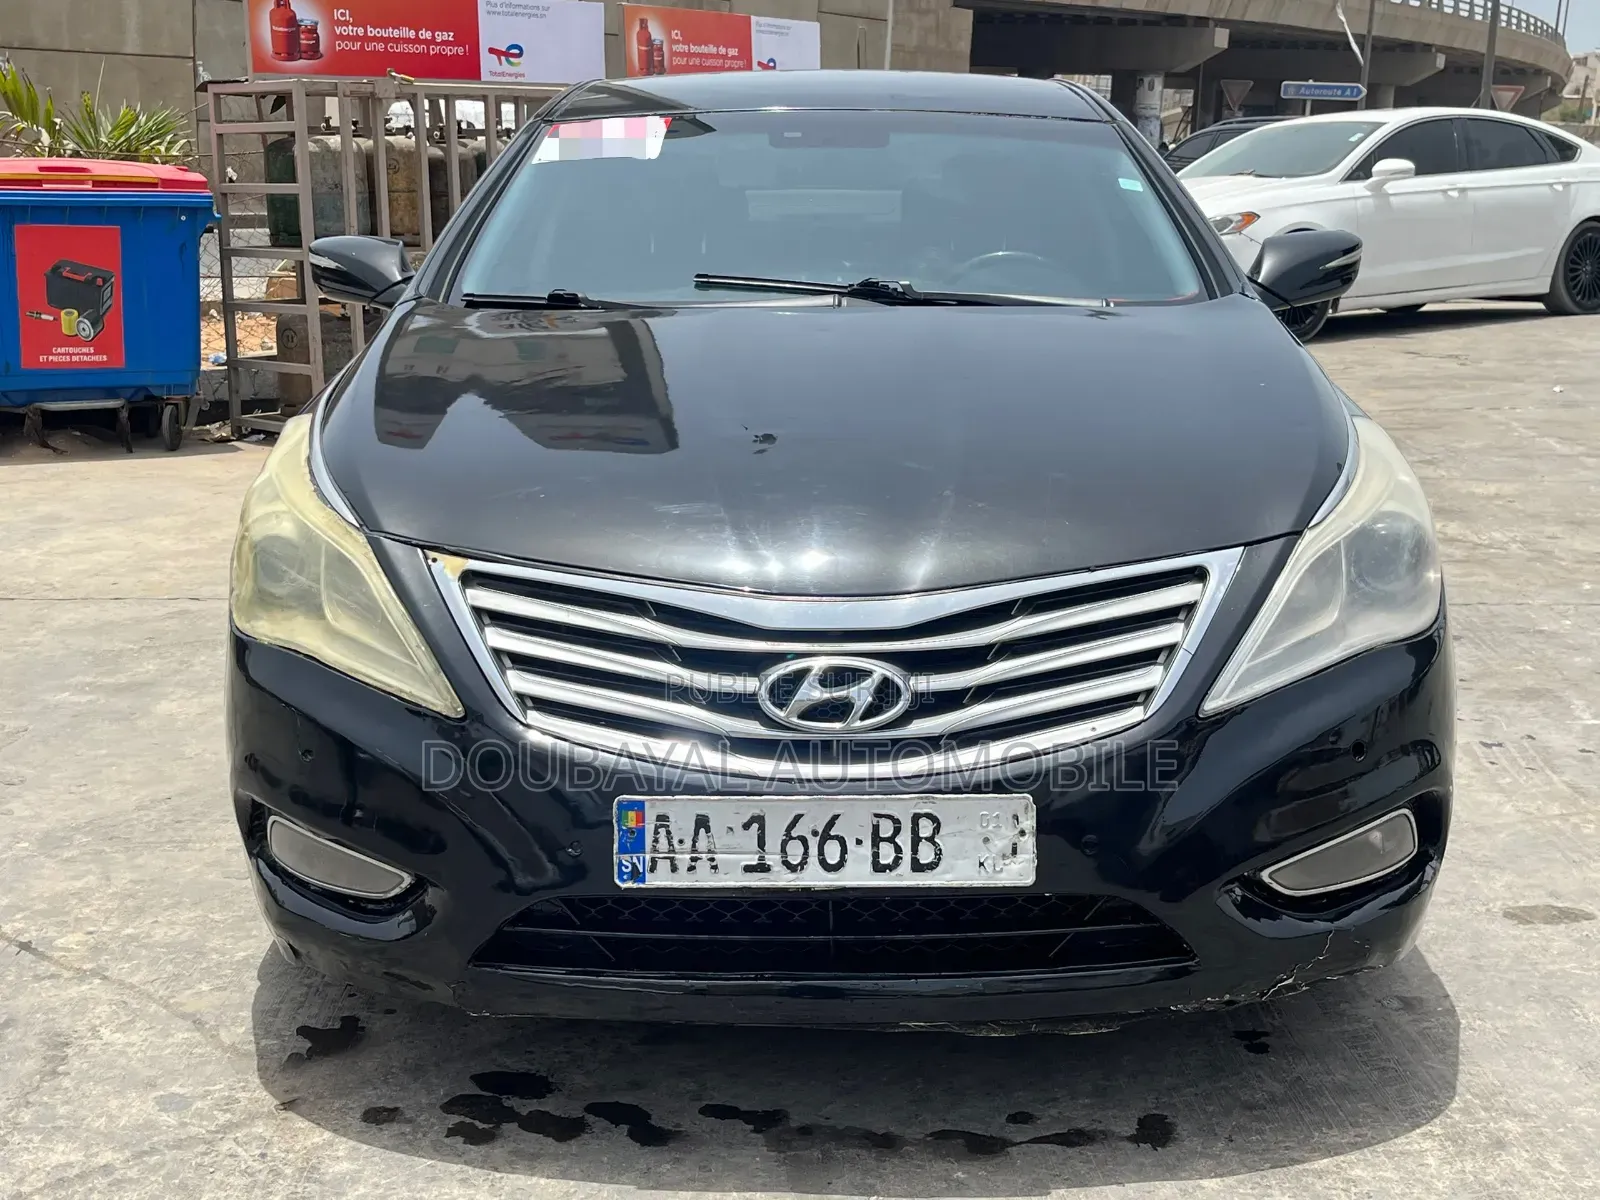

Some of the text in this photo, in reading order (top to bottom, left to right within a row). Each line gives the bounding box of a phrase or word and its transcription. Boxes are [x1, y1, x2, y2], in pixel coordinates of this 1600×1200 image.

[486, 1, 498, 9] Plus
[334, 9, 352, 22] ICI,
[334, 25, 454, 42] votre bouteille de gaz
[671, 30, 682, 41] ICI,
[336, 41, 361, 51] pour
[365, 42, 385, 52] une
[388, 41, 427, 53] cuisson
[672, 43, 739, 57] votre bouteille de gaz
[672, 56, 687, 65] pour
[701, 58, 724, 67] cuisson
[489, 70, 525, 79] TotalEnergies
[1299, 87, 1342, 96] Autoroute
